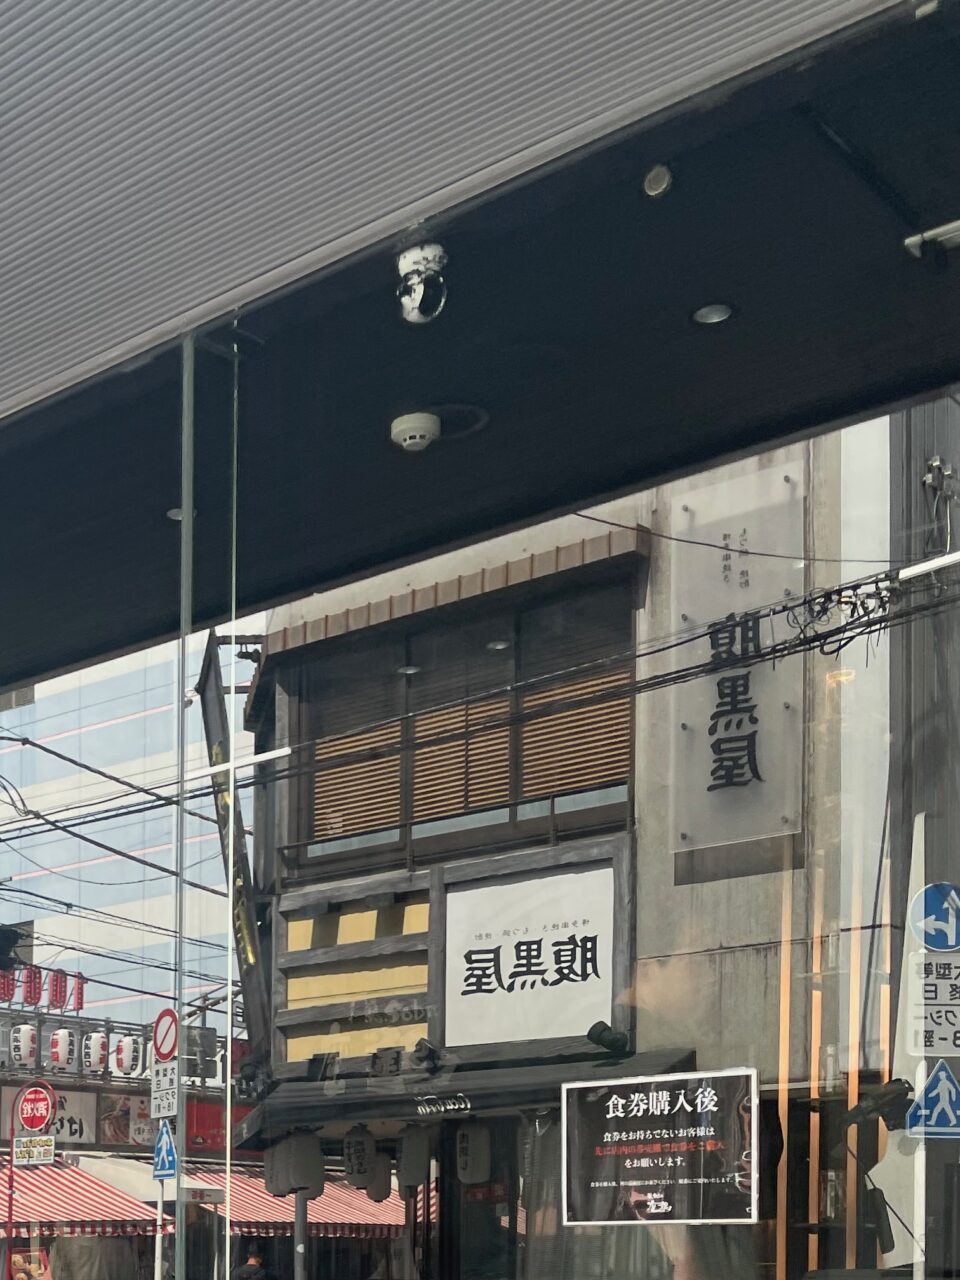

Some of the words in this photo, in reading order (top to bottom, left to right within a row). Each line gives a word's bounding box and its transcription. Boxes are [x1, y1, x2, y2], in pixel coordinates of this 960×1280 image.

[604, 1087, 720, 1119] 食券購入後
[602, 1126, 716, 1142] 食券をお持ちでないお客様は
[624, 1155, 687, 1169] をお願いします。
